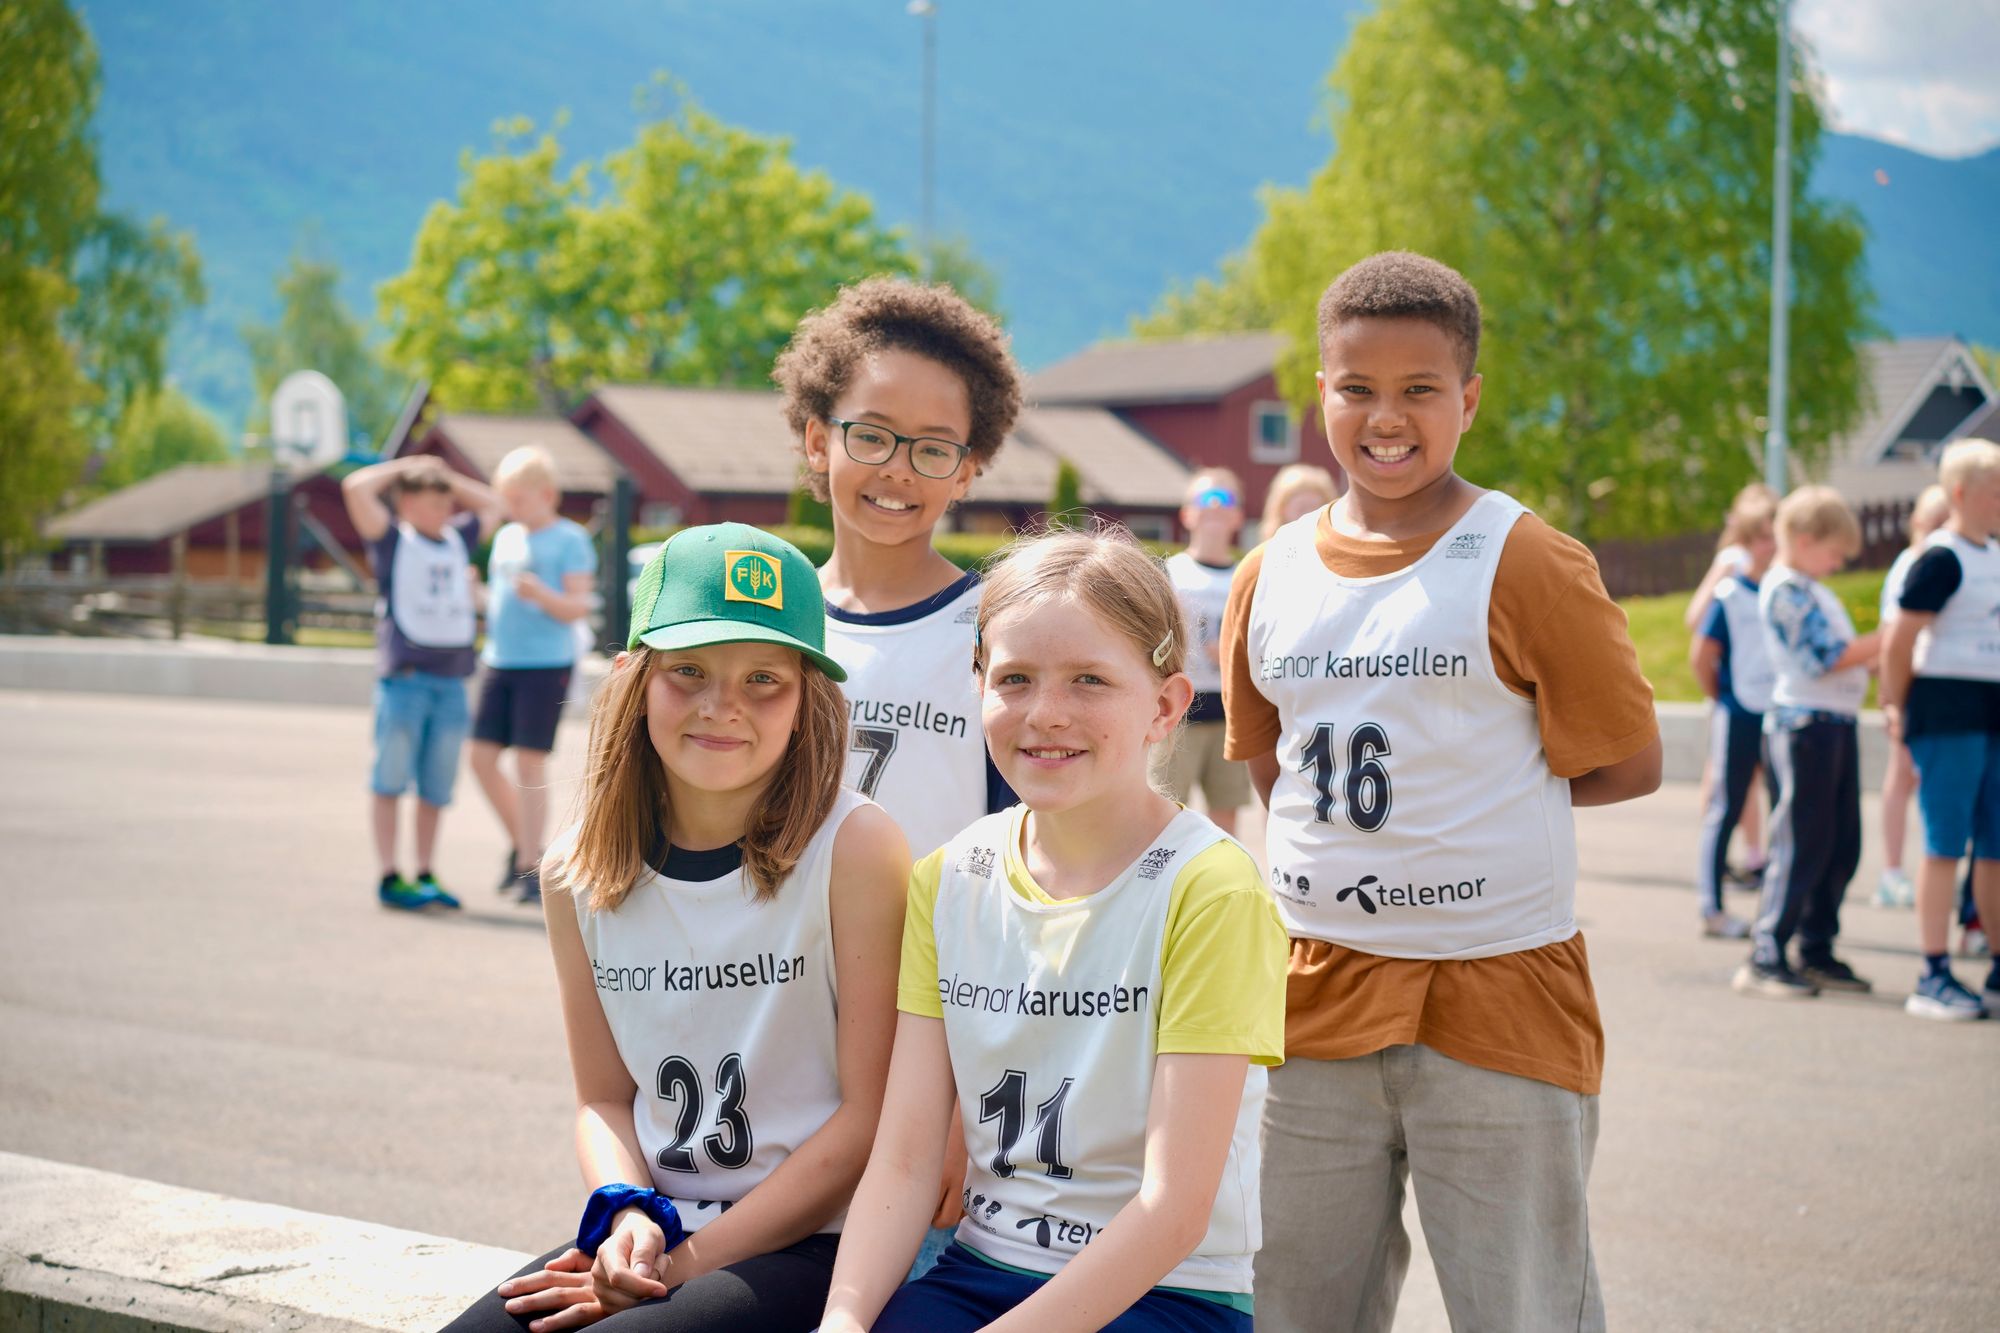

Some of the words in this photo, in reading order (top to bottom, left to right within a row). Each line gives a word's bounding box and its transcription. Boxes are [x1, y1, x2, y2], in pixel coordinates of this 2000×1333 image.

[1325, 647, 1467, 678] karusellen
[847, 699, 967, 738] rusellen
[1298, 722, 1393, 833] 16
[1376, 877, 1486, 907] telenor
[664, 952, 805, 992] karusellen
[938, 973, 1014, 1014] elenor
[656, 1052, 754, 1174] 23
[979, 1069, 1075, 1180] 11
